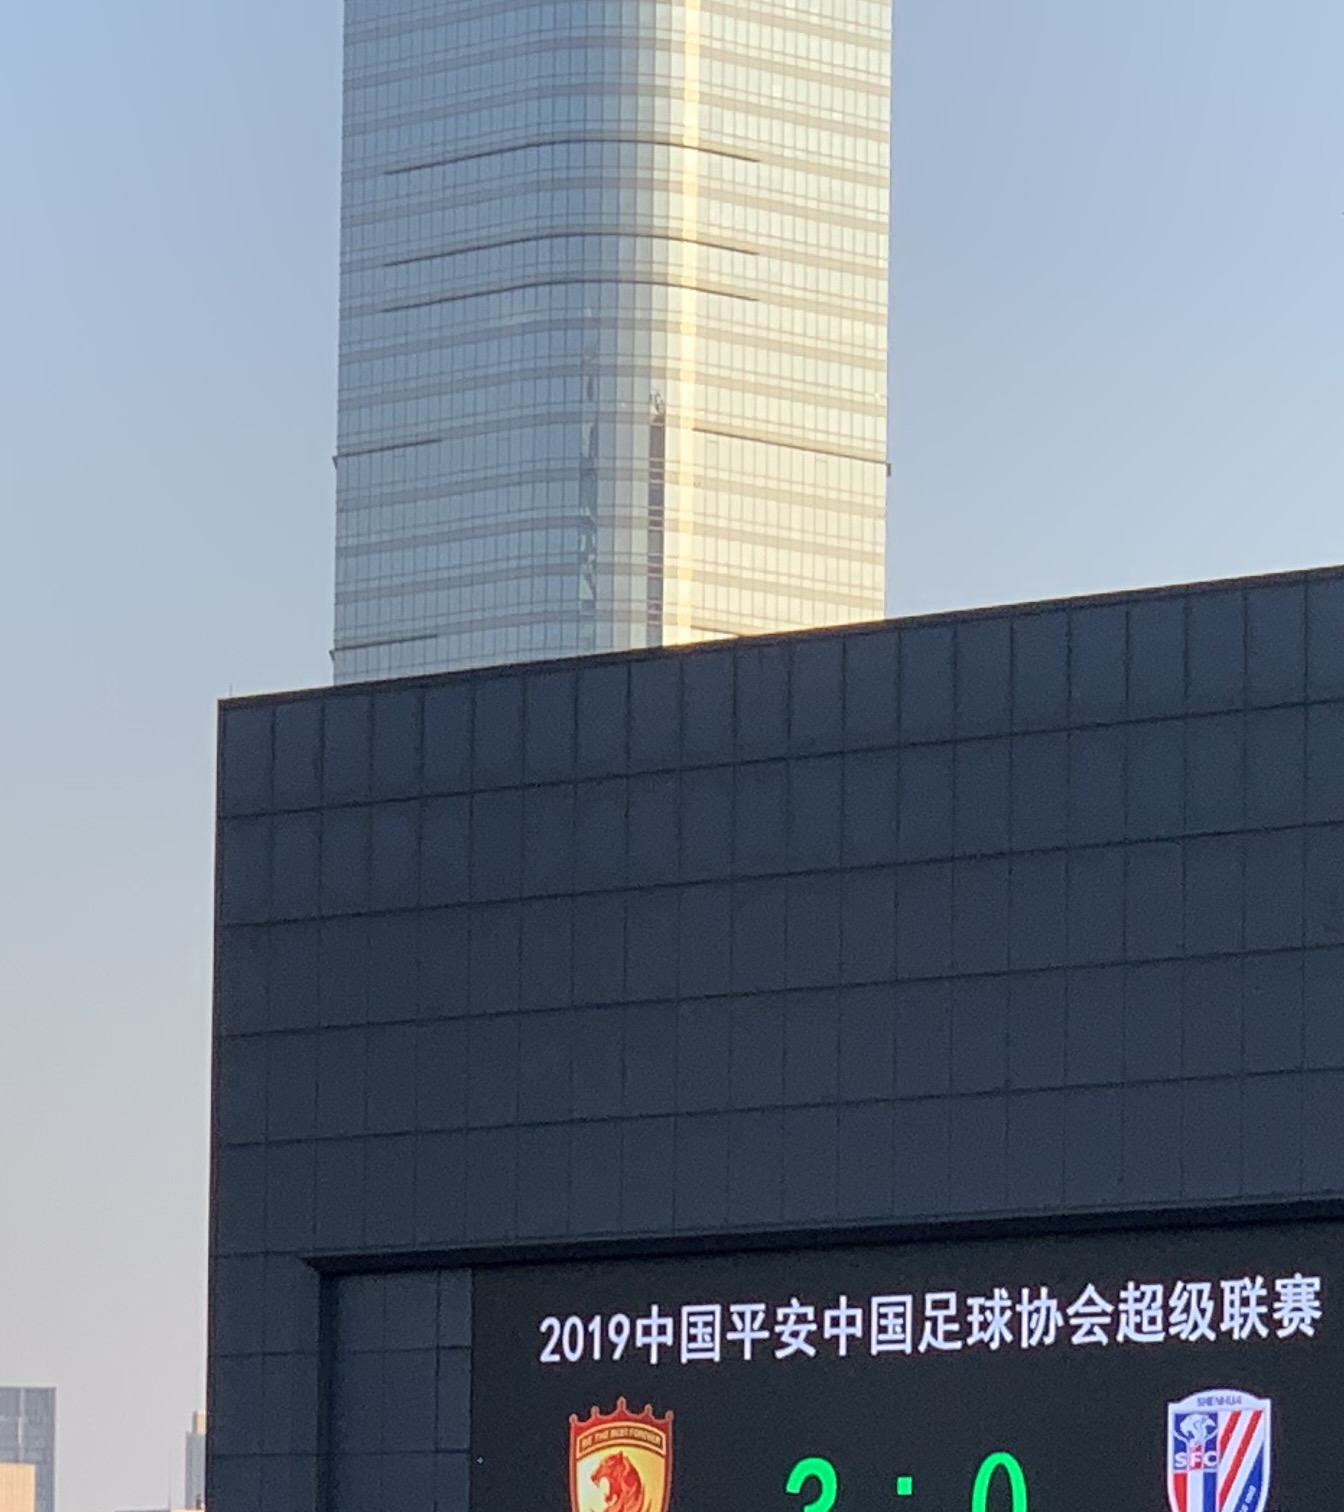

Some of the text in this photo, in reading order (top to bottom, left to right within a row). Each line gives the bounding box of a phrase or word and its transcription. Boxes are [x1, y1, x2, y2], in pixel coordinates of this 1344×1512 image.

[539, 1273, 1323, 1364] 2019中国平安中国足球协会超级联赛
[1174, 1451, 1218, 1469] SFC
